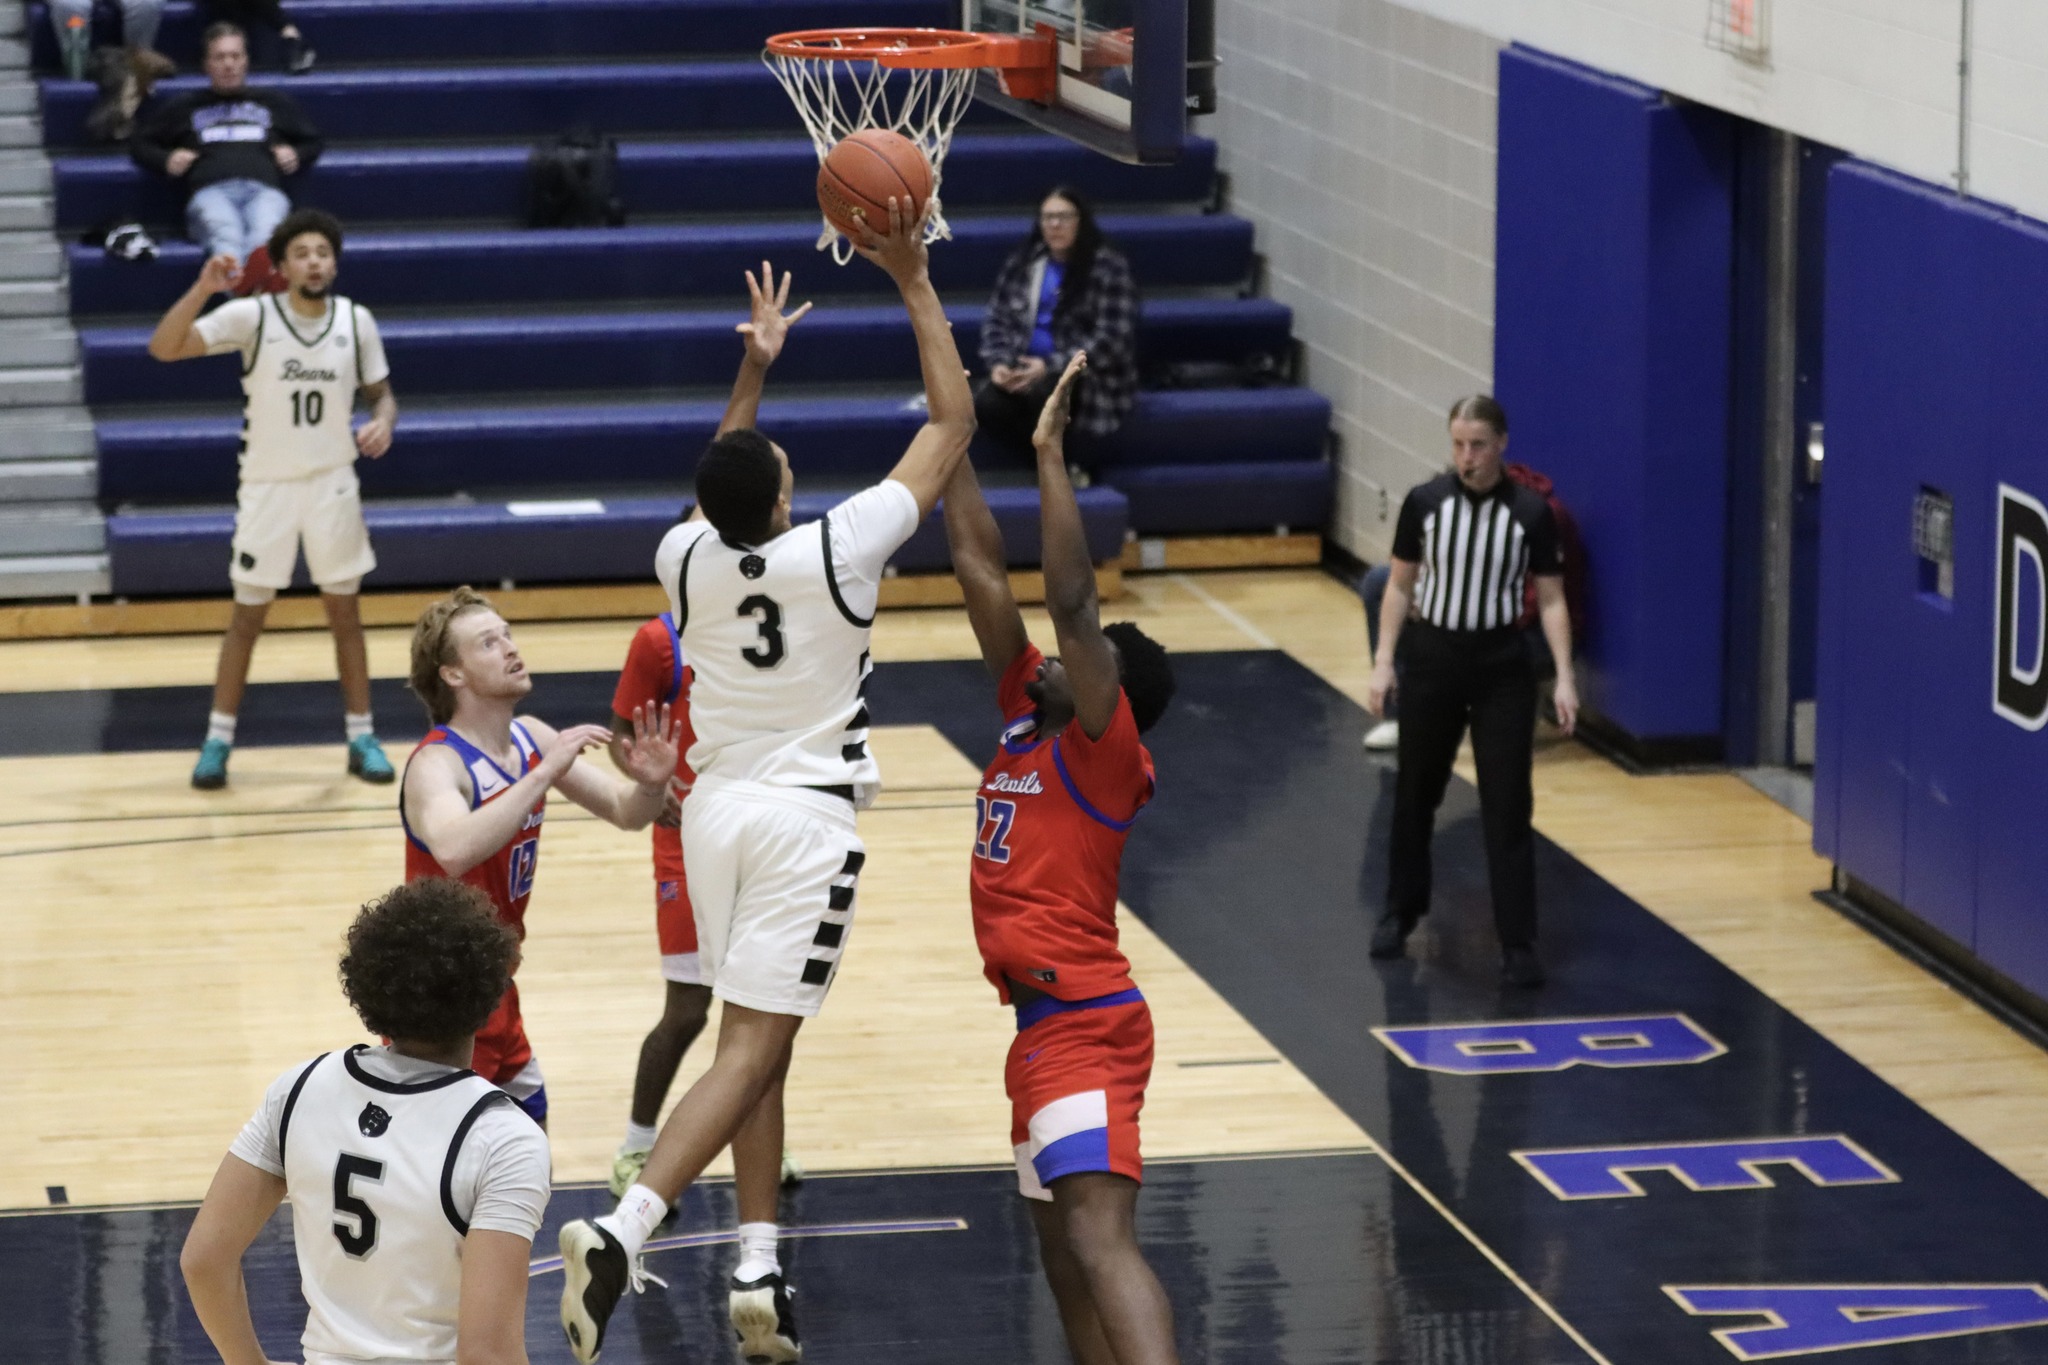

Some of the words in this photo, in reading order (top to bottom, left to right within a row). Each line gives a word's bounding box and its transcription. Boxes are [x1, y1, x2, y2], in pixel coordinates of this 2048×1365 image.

[280, 358, 337, 382] Bears
[291, 390, 324, 427] 10
[735, 592, 789, 672] 3
[1992, 481, 2048, 732] D
[986, 771, 1044, 794] Devils
[508, 837, 539, 903] 12
[331, 1148, 389, 1263] 5
